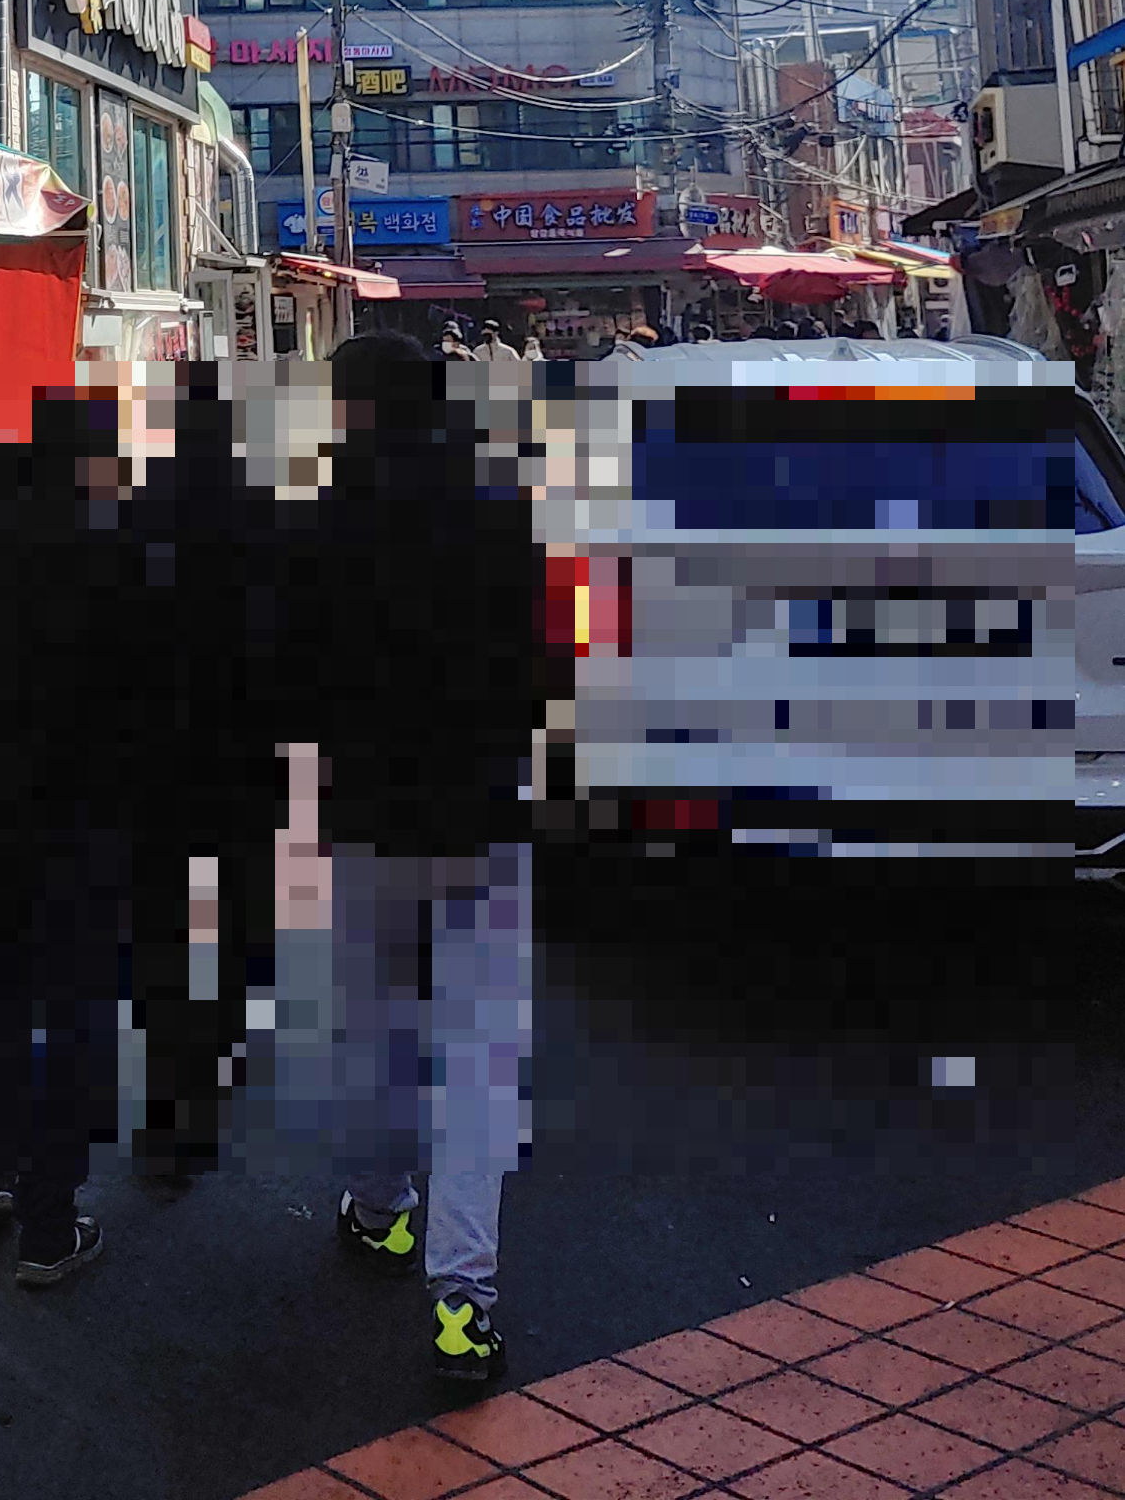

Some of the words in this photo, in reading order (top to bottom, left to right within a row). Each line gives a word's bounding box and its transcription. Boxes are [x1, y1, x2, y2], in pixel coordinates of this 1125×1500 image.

[355, 69, 408, 95] 酒吧
[383, 211, 438, 233] 백화점
[492, 201, 637, 228] 中国食品批发
